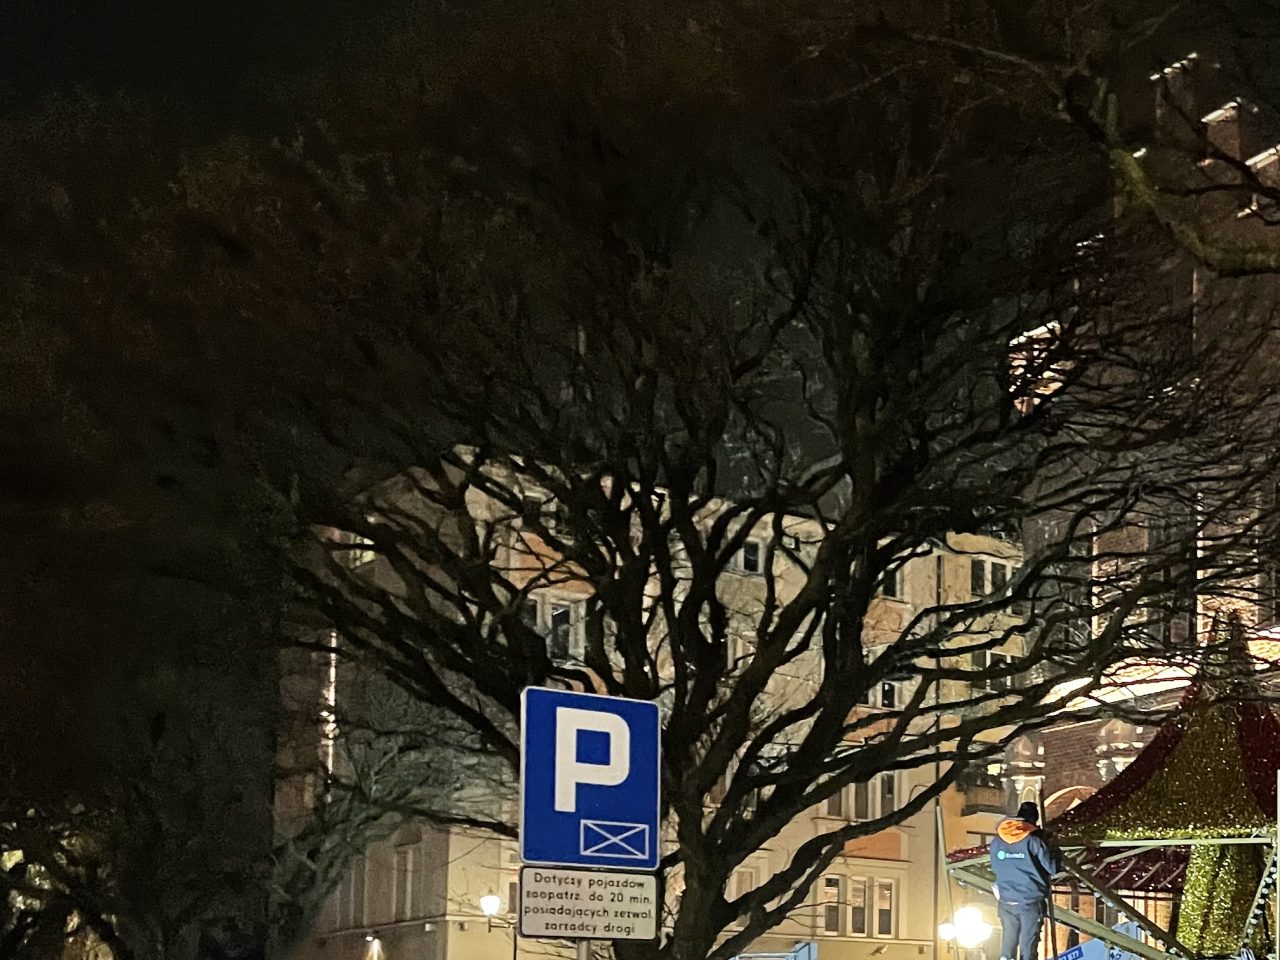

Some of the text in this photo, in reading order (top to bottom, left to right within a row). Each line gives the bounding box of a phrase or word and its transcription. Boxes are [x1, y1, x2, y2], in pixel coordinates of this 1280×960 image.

[554, 706, 631, 813] P
[534, 872, 583, 888] Dotyczy
[588, 891, 604, 902] do
[610, 892, 624, 903] 20
[603, 922, 635, 936] drogi
